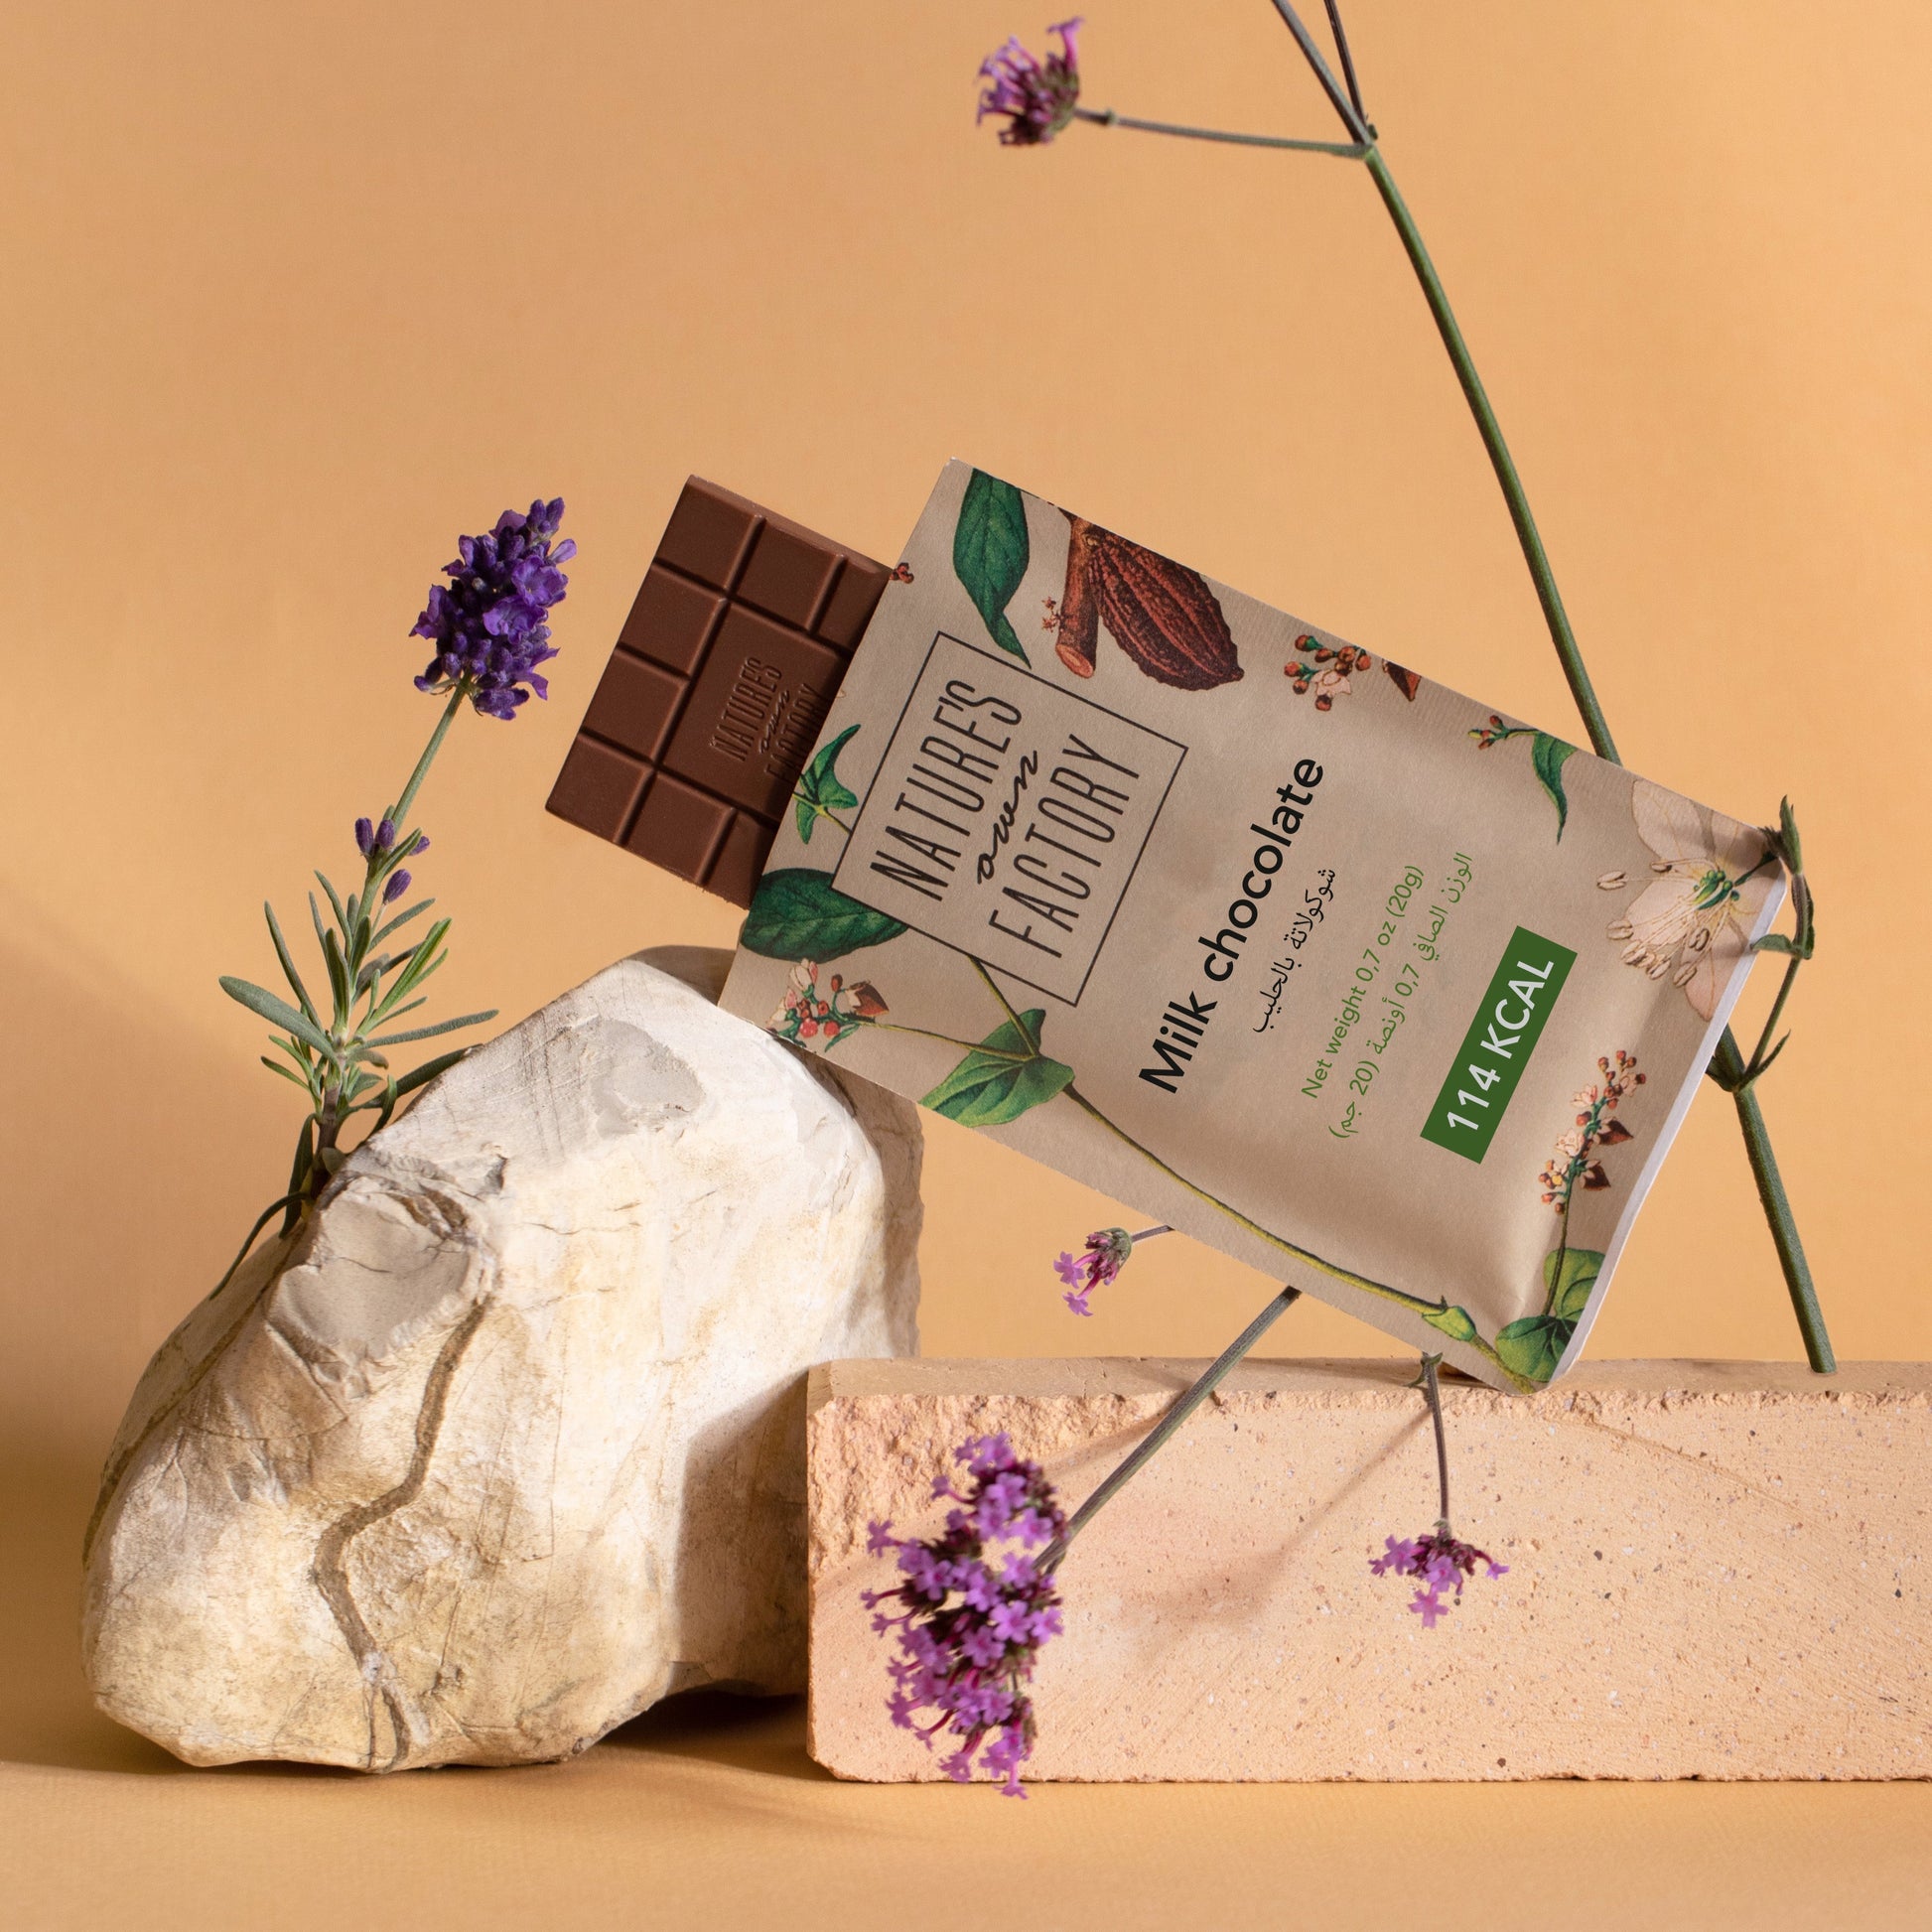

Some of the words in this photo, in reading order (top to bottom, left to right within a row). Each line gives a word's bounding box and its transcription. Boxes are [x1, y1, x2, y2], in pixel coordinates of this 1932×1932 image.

[870, 680, 1023, 901] NATURE'S
[977, 750, 1038, 885] own
[989, 734, 1140, 959] FACTORY
[1441, 852, 1472, 903] الوزن
[1283, 869, 1336, 949] شوكولاتة
[1385, 865, 1425, 917] (20g)
[1138, 991, 1218, 1093] Milk
[1197, 758, 1323, 982] chocolate
[1377, 920, 1397, 946] oz
[1412, 904, 1449, 961] الصافي
[1252, 957, 1303, 1034] بالحليب
[1355, 948, 1380, 982] 0,7
[1394, 962, 1420, 997] 0,7
[1325, 986, 1367, 1054] weight
[1365, 996, 1406, 1054] أونصة
[1447, 1063, 1501, 1131] 114
[1479, 960, 1555, 1059] KCAL
[1301, 1058, 1332, 1099] Net
